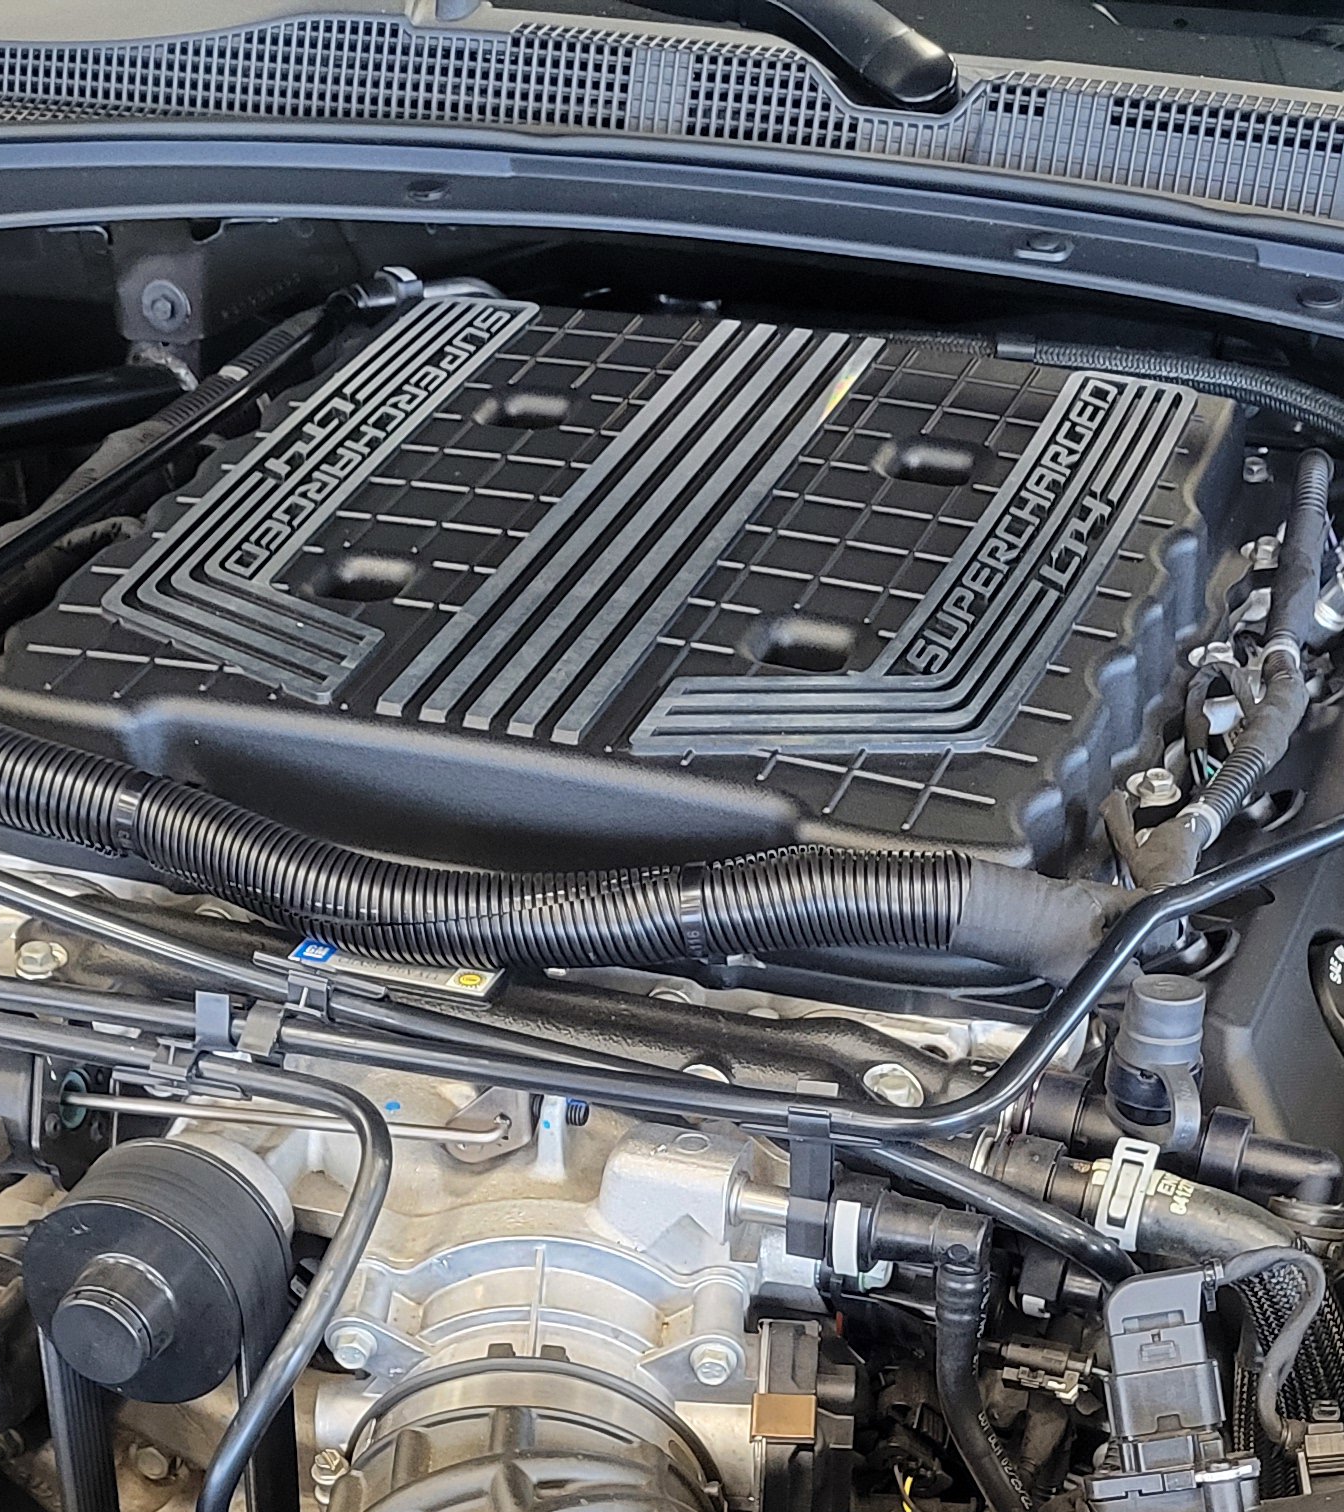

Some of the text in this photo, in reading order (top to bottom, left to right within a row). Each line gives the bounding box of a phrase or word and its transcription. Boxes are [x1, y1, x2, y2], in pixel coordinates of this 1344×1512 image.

[225, 307, 513, 581] SUPERCHARGED
[264, 393, 358, 486] LT4
[907, 377, 1120, 675] SUPERCHARGED
[1038, 489, 1118, 596] LT4
[303, 944, 328, 958] GM
